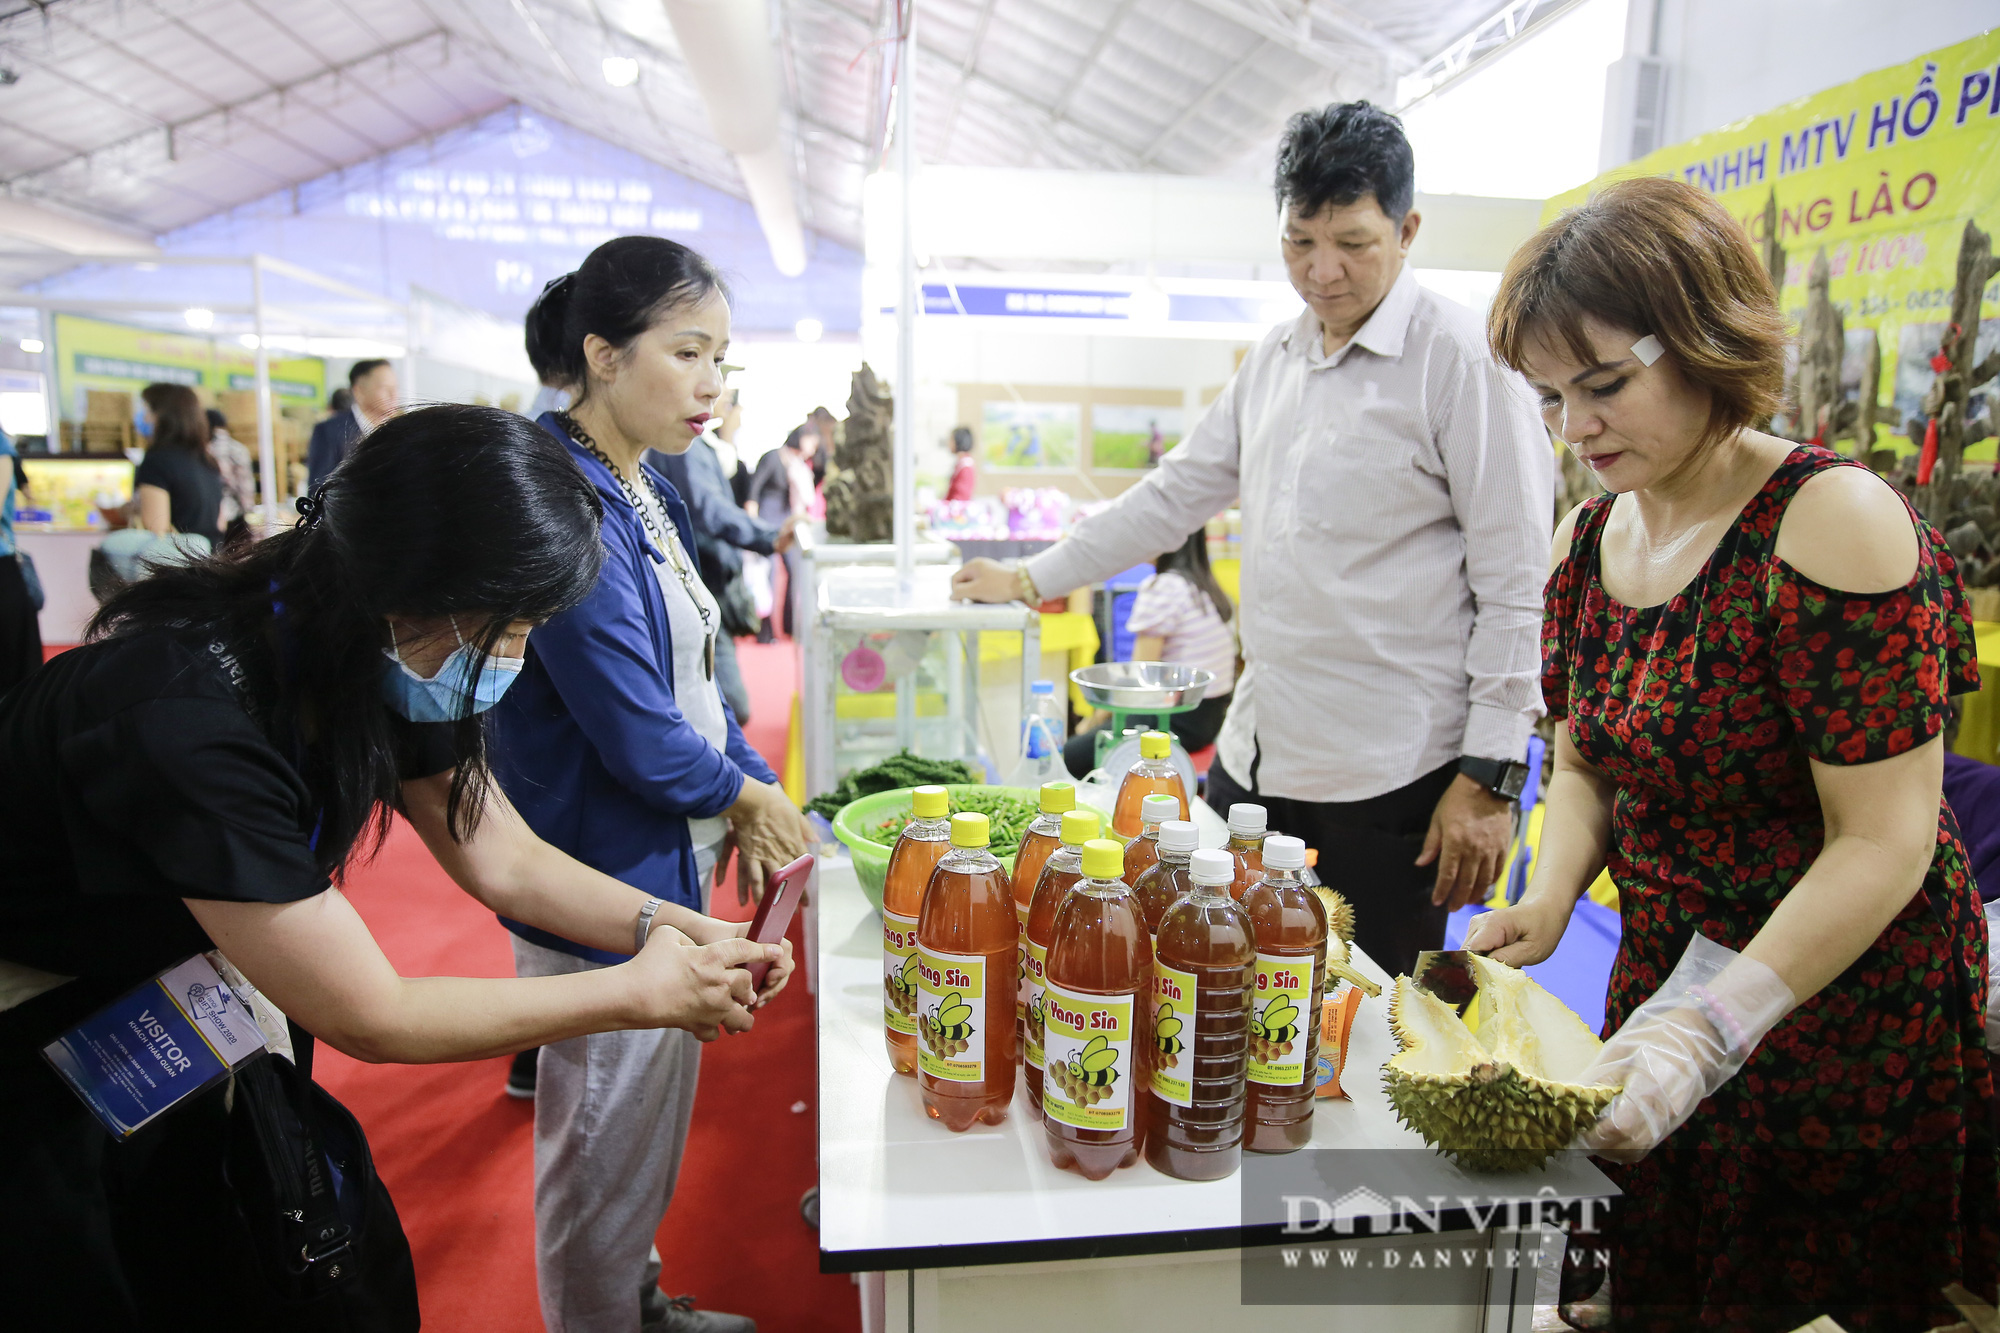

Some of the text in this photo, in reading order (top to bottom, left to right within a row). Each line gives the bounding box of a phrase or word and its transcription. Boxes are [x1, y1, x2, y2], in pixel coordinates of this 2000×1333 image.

[1779, 111, 1857, 175] MTV
[1868, 63, 1940, 149] HỒ
[1848, 171, 1938, 225] LÀO
[945, 968, 970, 987] Sin
[1161, 977, 1182, 1000] Sin
[1273, 970, 1299, 989] Sin
[197, 995, 237, 1044] GIFT SHOW 2020
[1050, 999, 1085, 1031] Yang
[1090, 1010, 1117, 1030] Sin
[136, 1007, 191, 1075] VISITOR
[159, 1058, 176, 1078] QUAN
